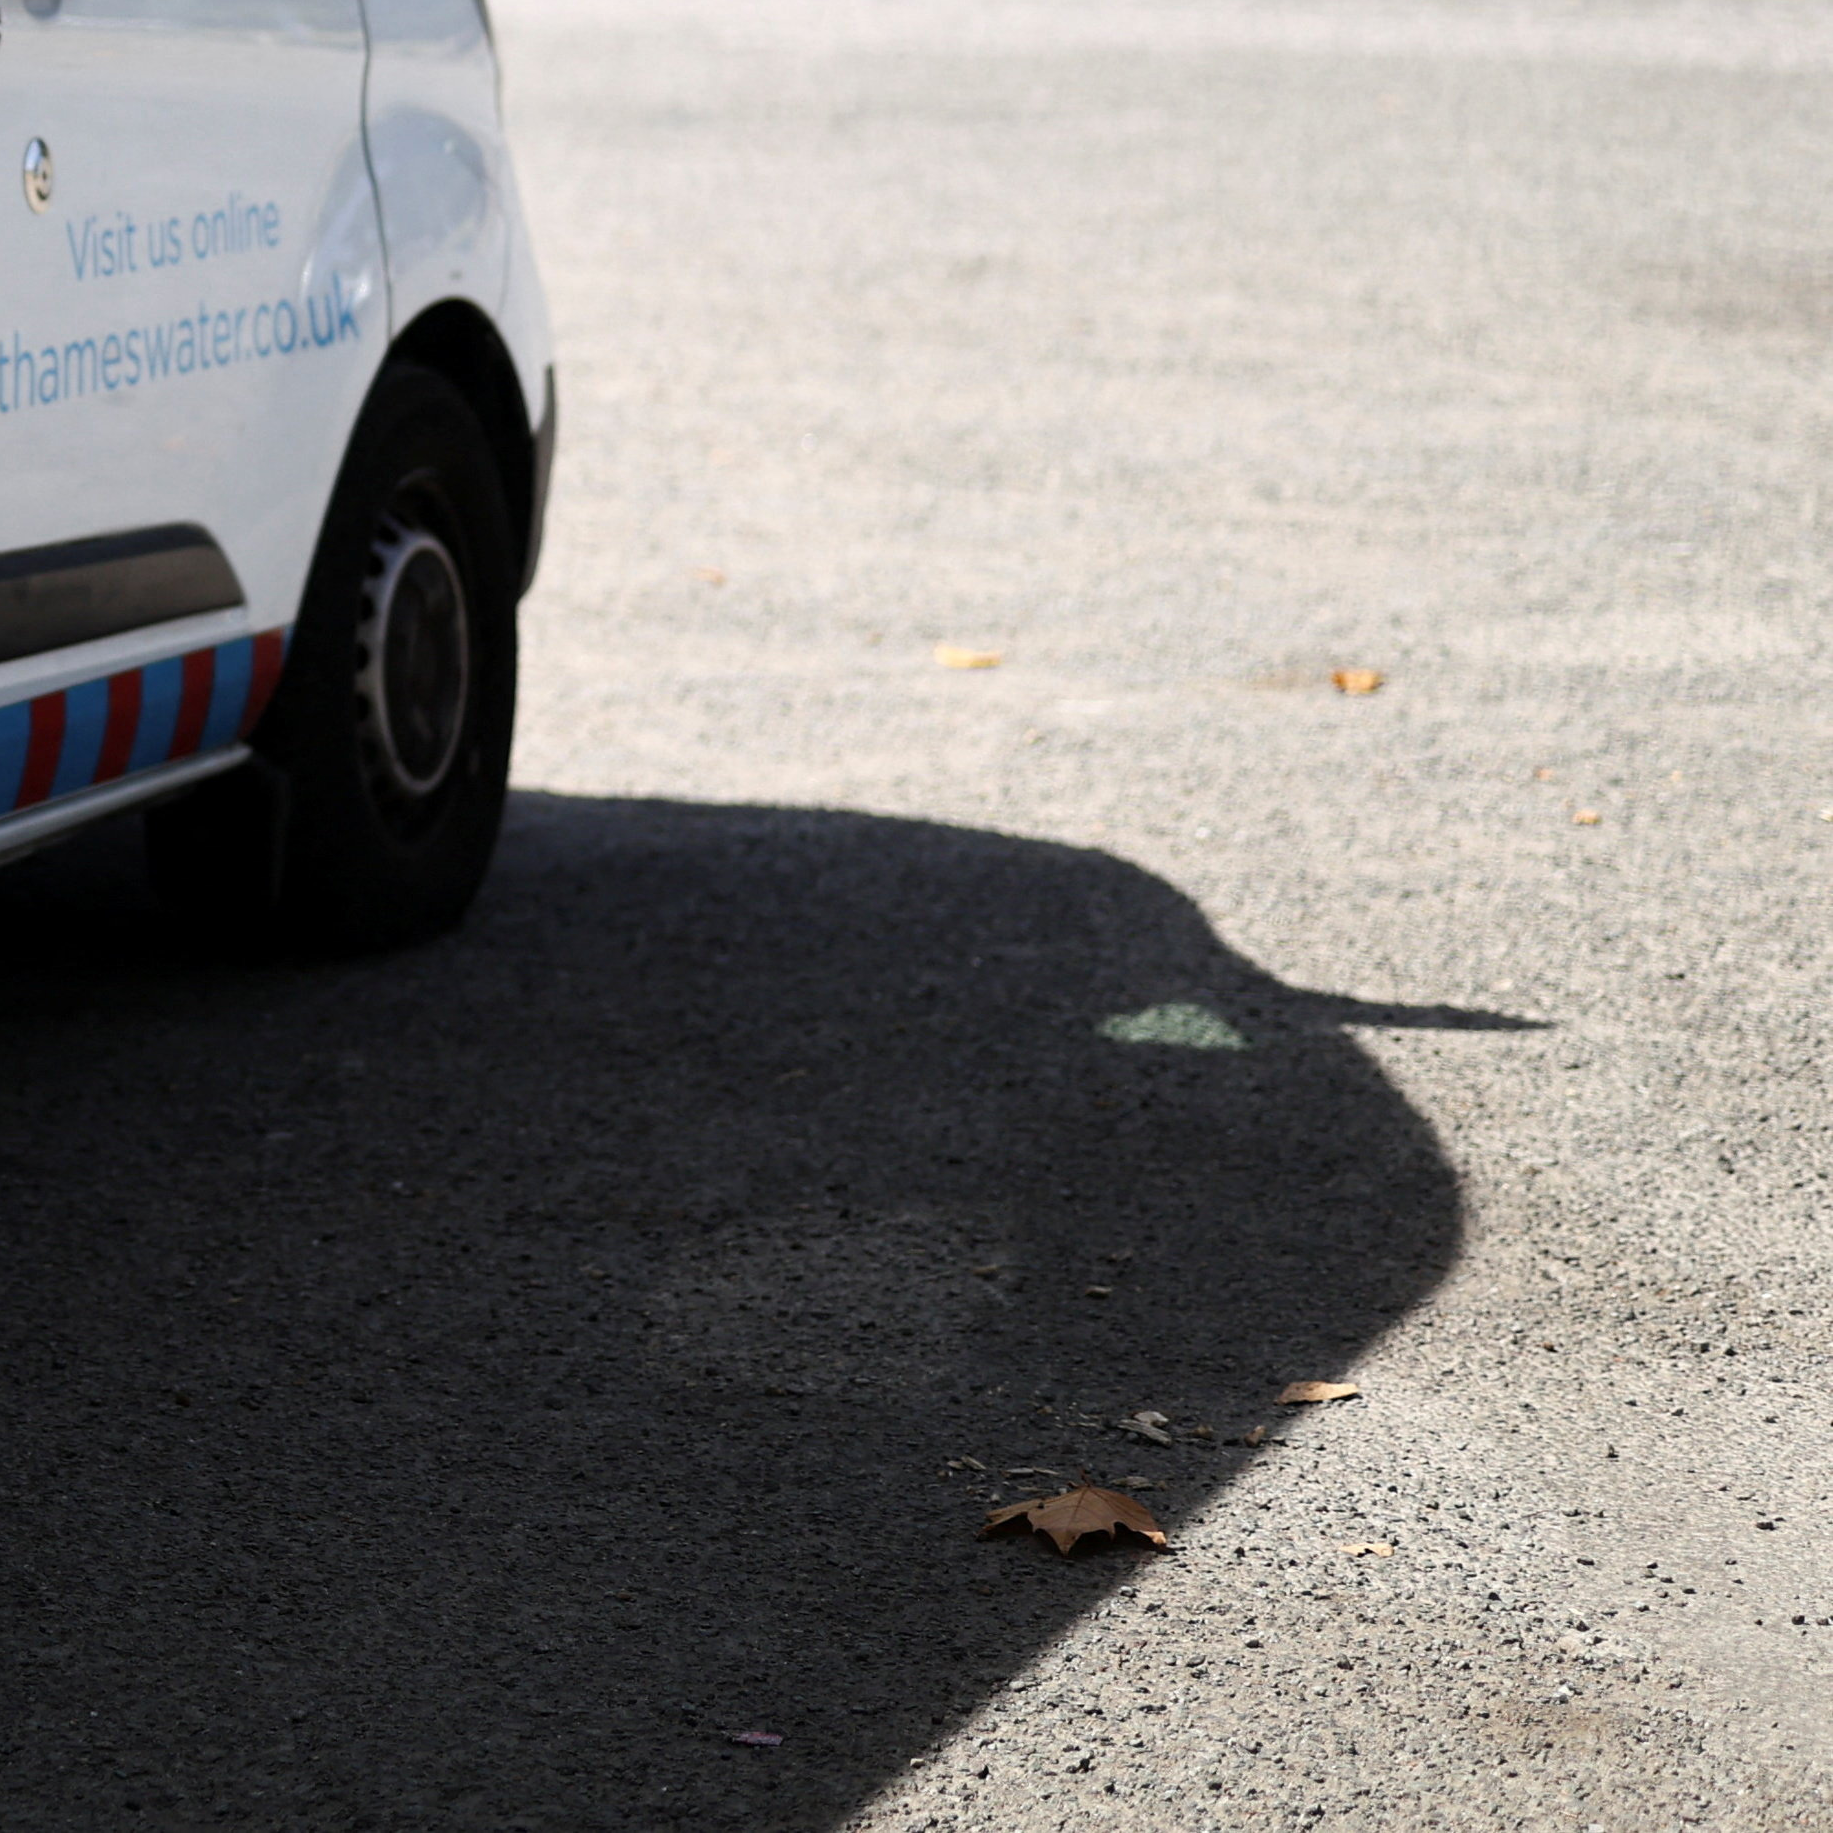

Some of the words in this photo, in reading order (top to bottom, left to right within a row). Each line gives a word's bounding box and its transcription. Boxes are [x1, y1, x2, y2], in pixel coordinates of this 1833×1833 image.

[66, 210, 138, 281] Visit
[147, 216, 182, 268] us
[192, 190, 280, 259] online
